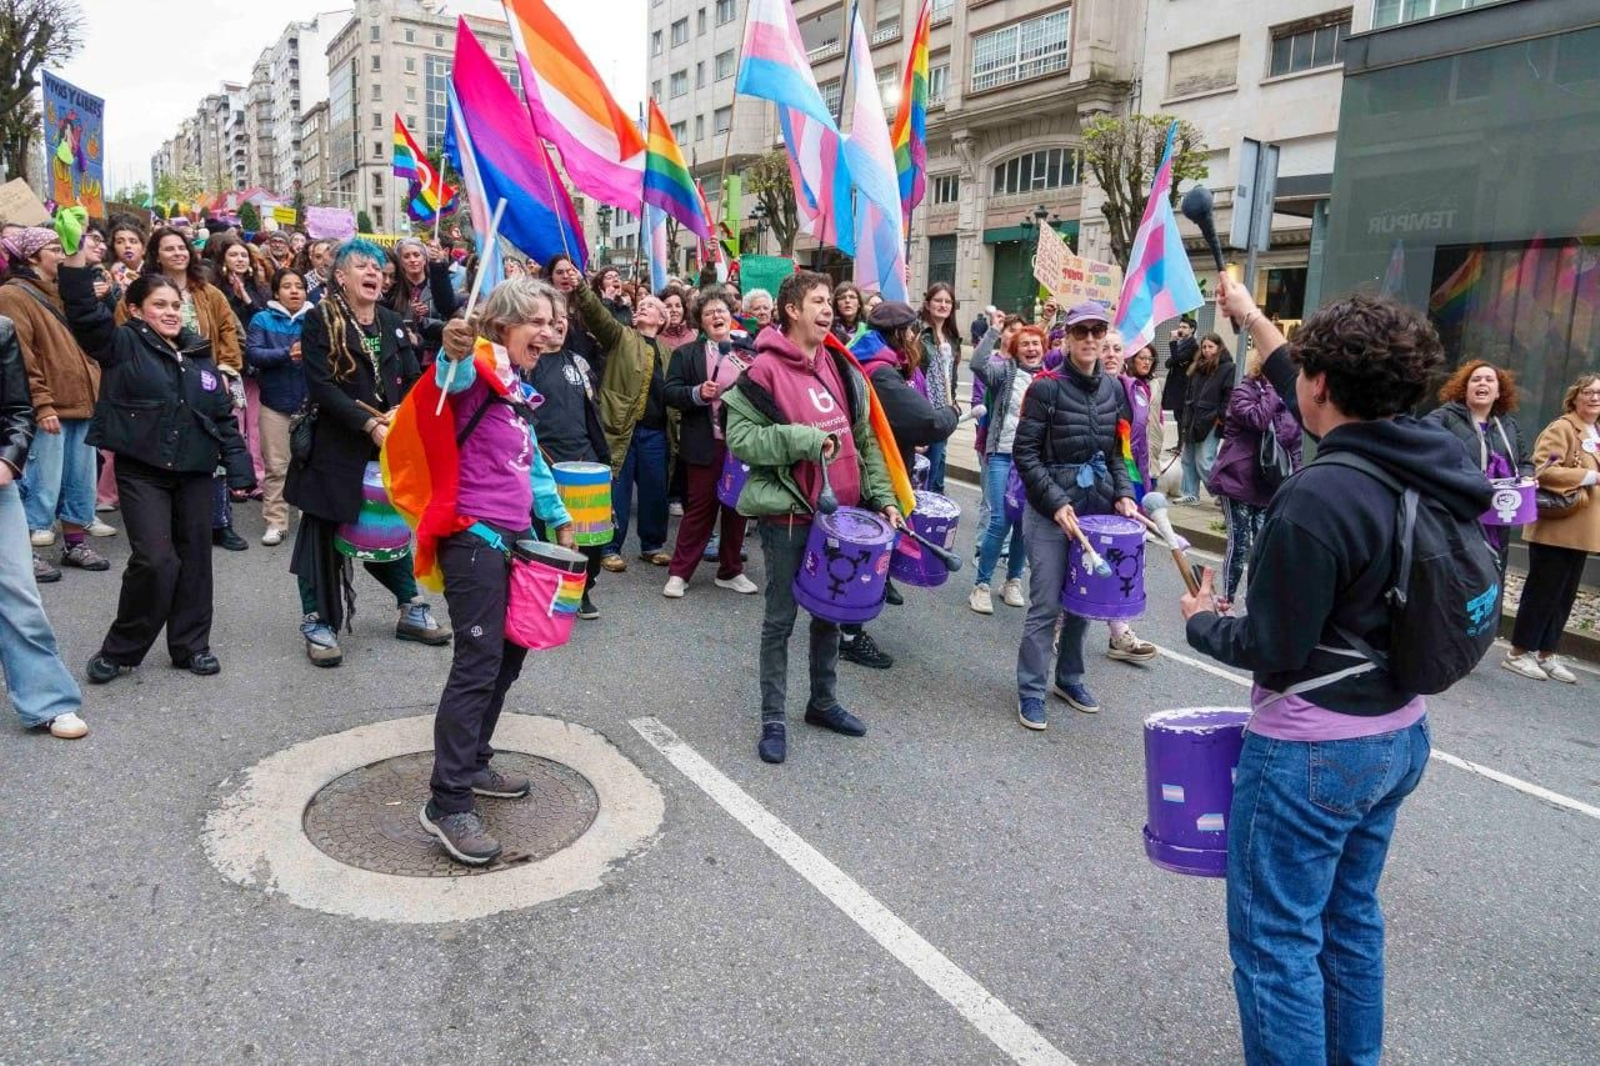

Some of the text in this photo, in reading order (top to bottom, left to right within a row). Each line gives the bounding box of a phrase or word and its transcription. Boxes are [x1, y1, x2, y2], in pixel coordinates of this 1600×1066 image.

[44, 74, 102, 118] VIVAS Y LIBRES
